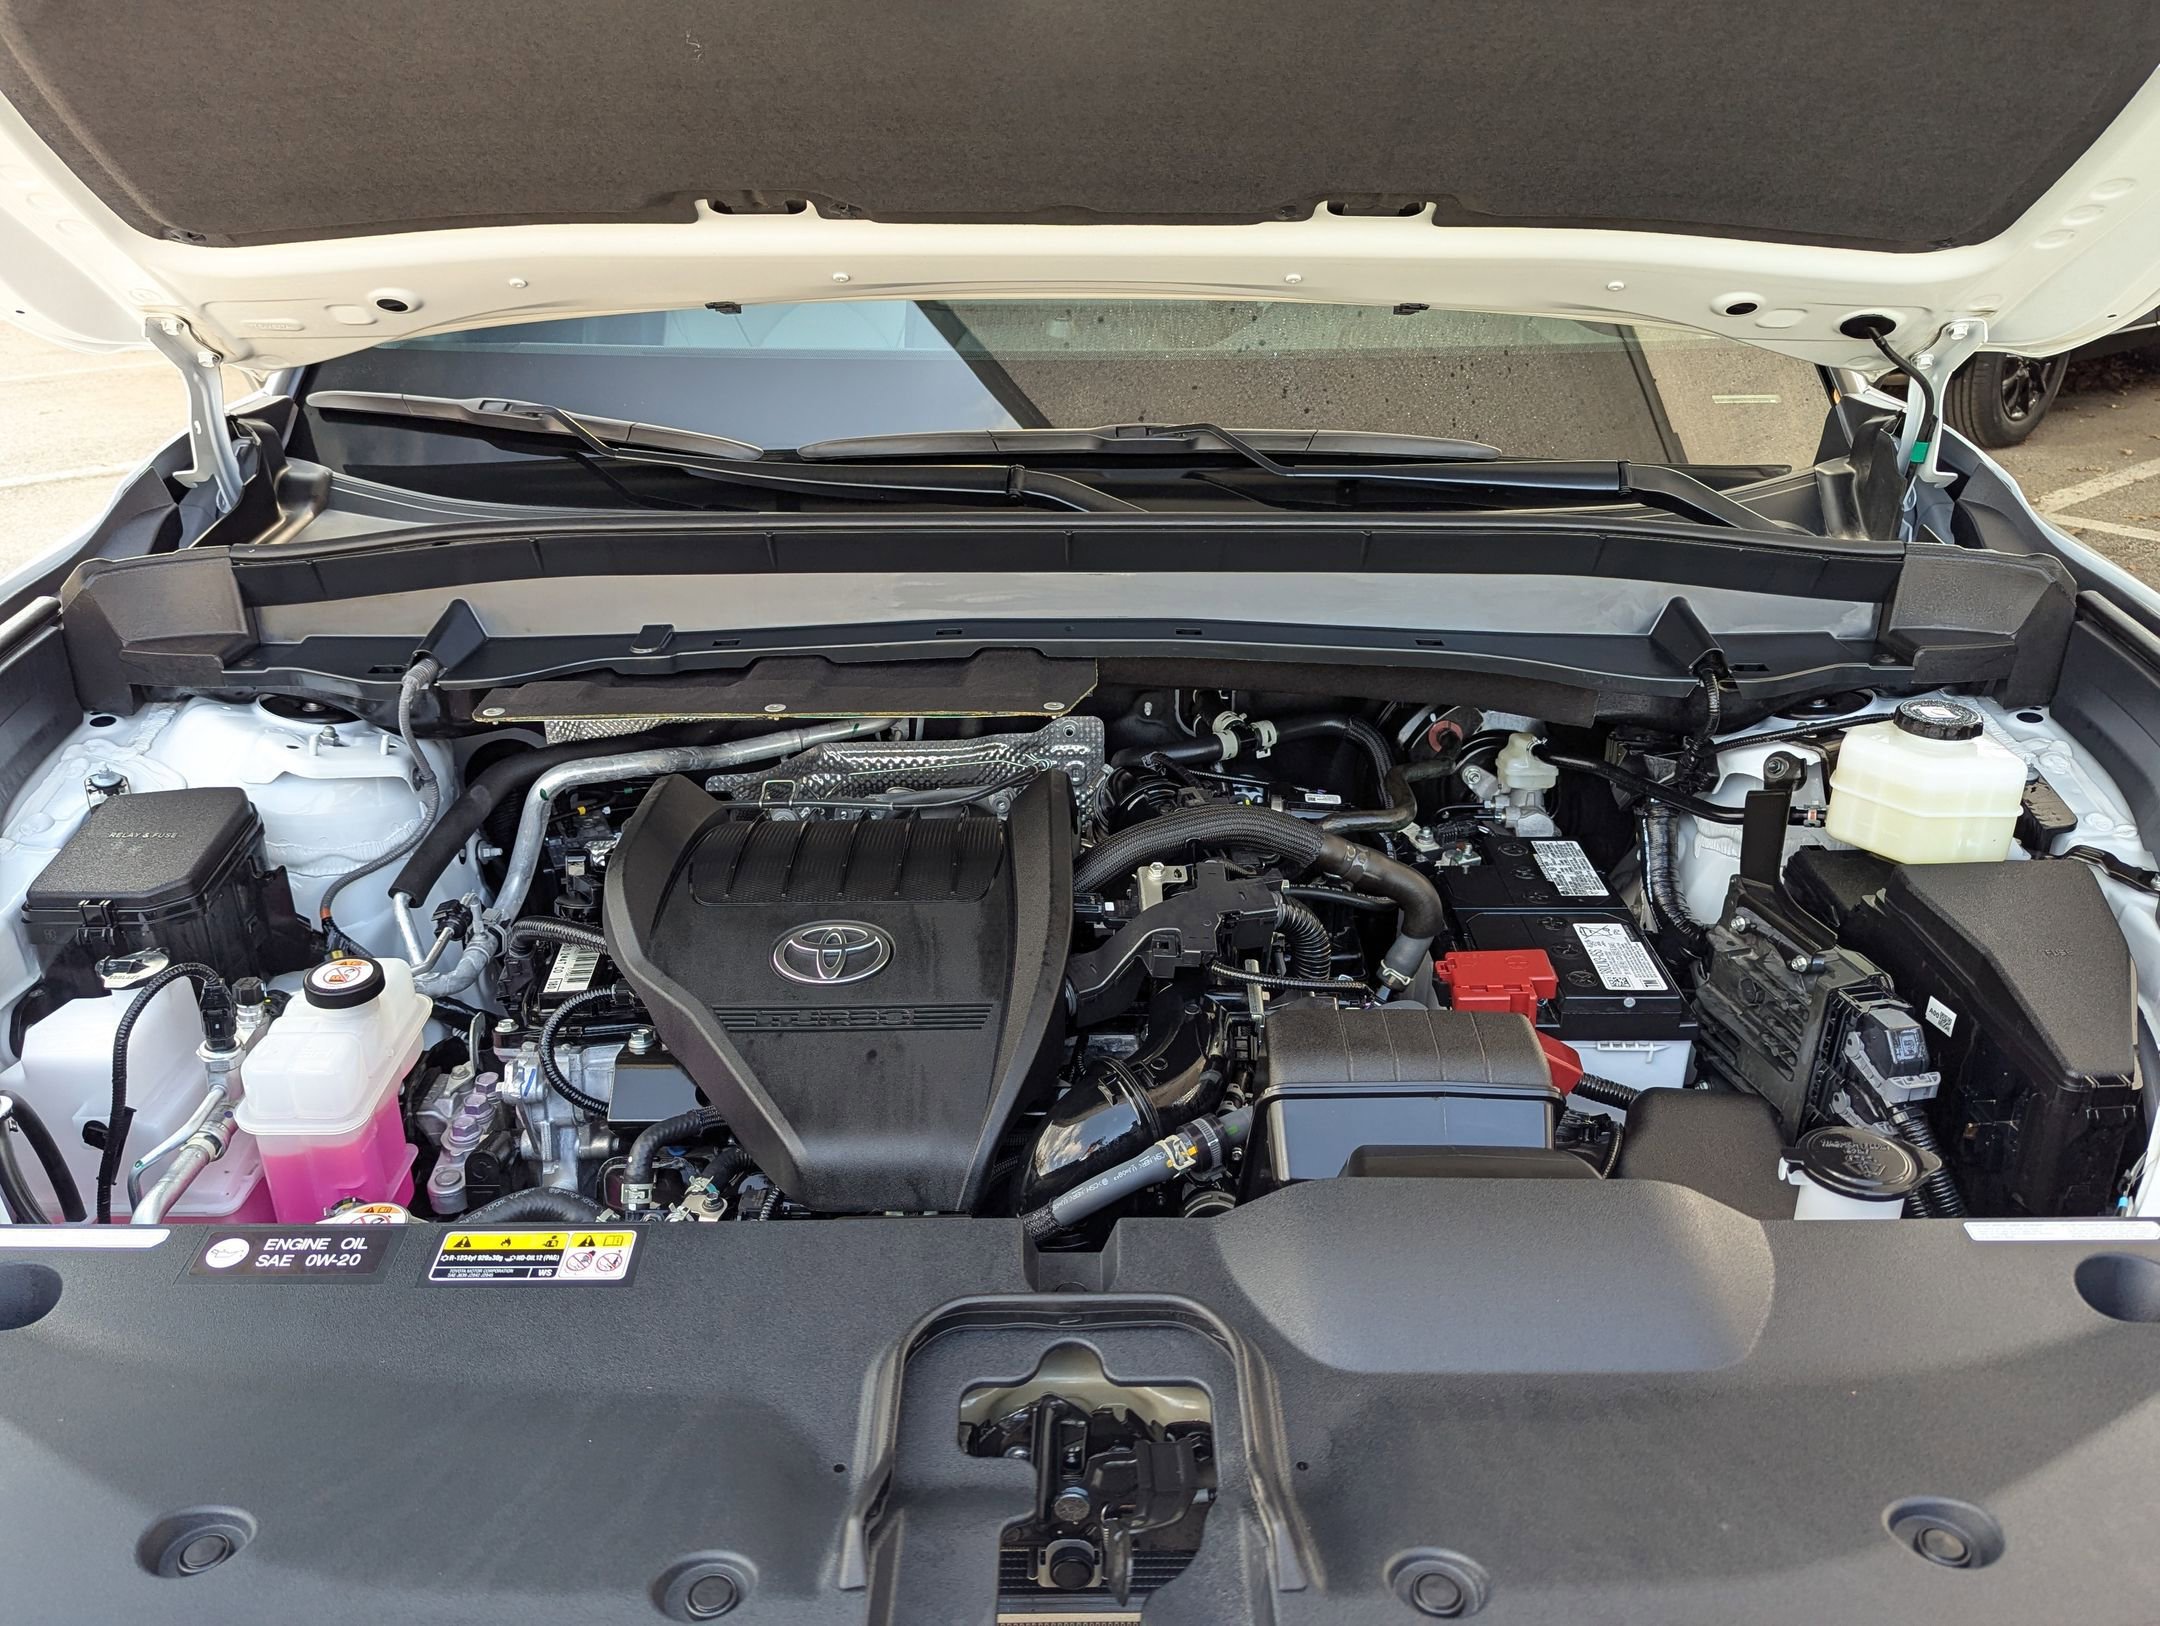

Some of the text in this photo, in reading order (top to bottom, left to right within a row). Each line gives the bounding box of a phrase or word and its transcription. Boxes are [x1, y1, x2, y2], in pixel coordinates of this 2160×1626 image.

[760, 1008, 913, 1027] TURBO
[263, 1237, 368, 1250] ENGINE OIL
[255, 1253, 361, 1267] SAE 0W-20
[538, 1269, 553, 1277] WS
